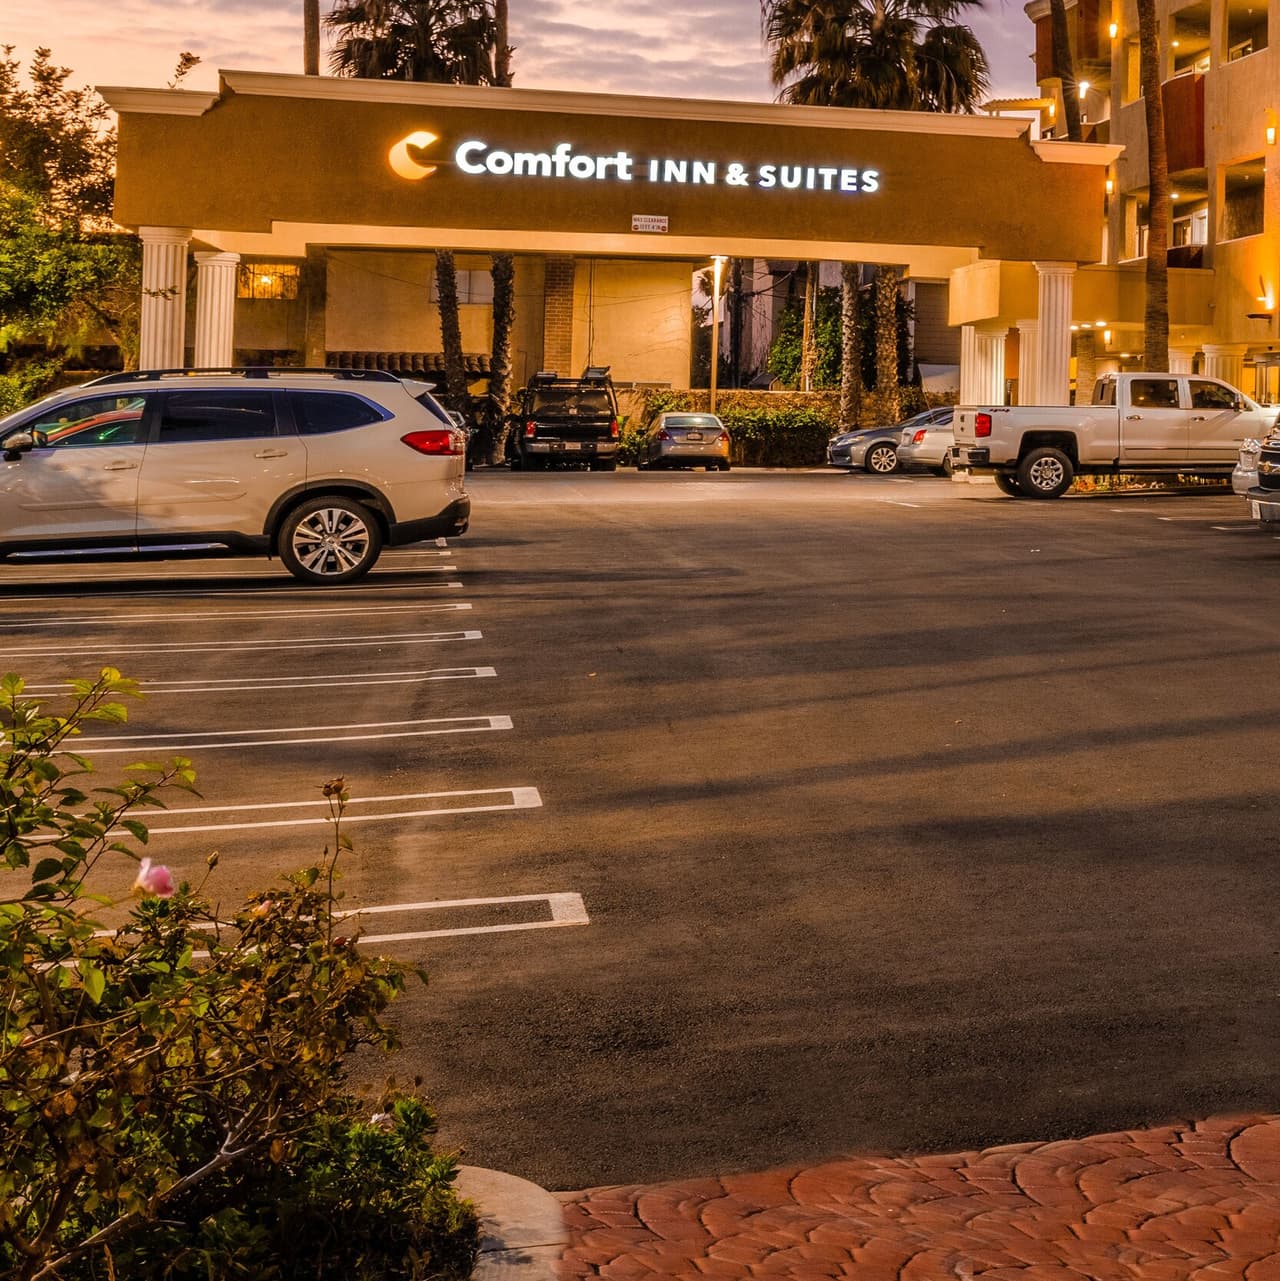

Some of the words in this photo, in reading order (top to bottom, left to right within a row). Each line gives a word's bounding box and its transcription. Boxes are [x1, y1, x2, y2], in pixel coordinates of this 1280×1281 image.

[454, 140, 633, 182] Comfort
[649, 159, 715, 185] INN
[725, 162, 749, 187] &
[759, 165, 880, 193] SUITES
